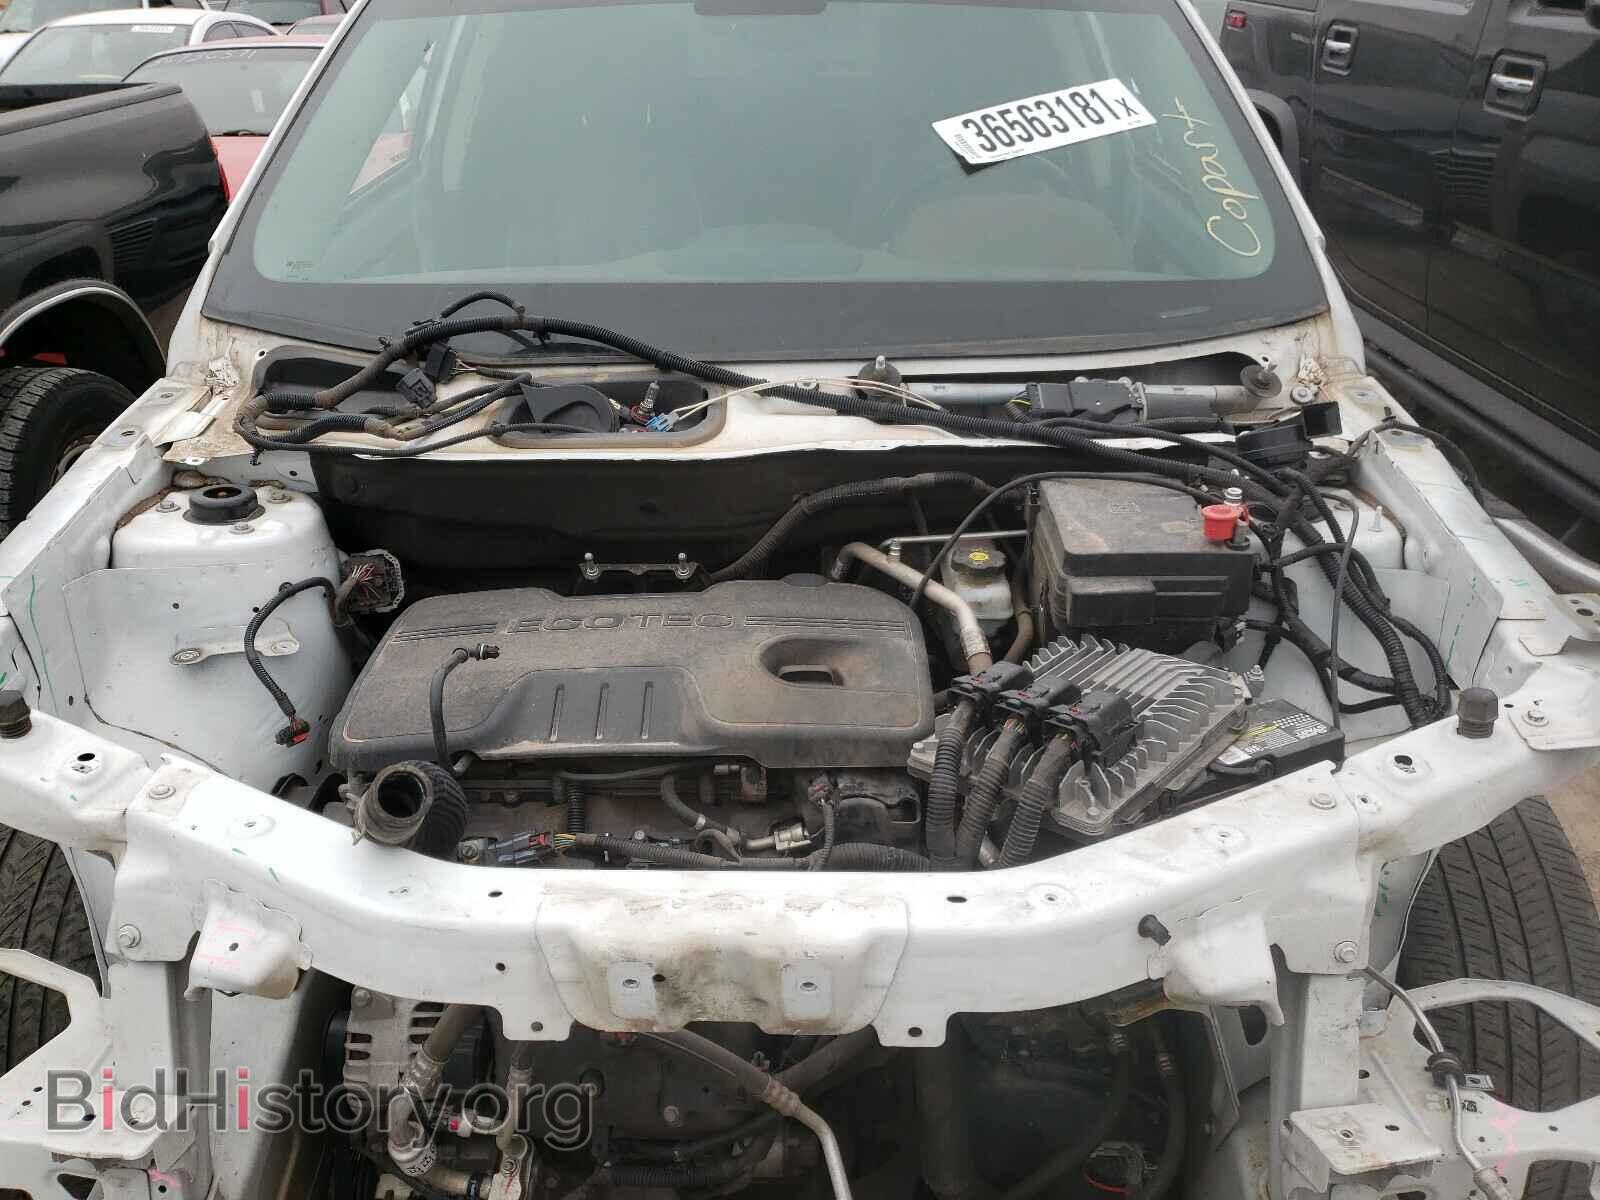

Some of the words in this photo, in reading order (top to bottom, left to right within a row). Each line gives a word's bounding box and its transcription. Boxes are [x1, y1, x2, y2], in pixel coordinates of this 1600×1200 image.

[961, 87, 1121, 153] 36563181
[1161, 96, 1262, 257] Copart
[505, 612, 735, 635] ECOTEC
